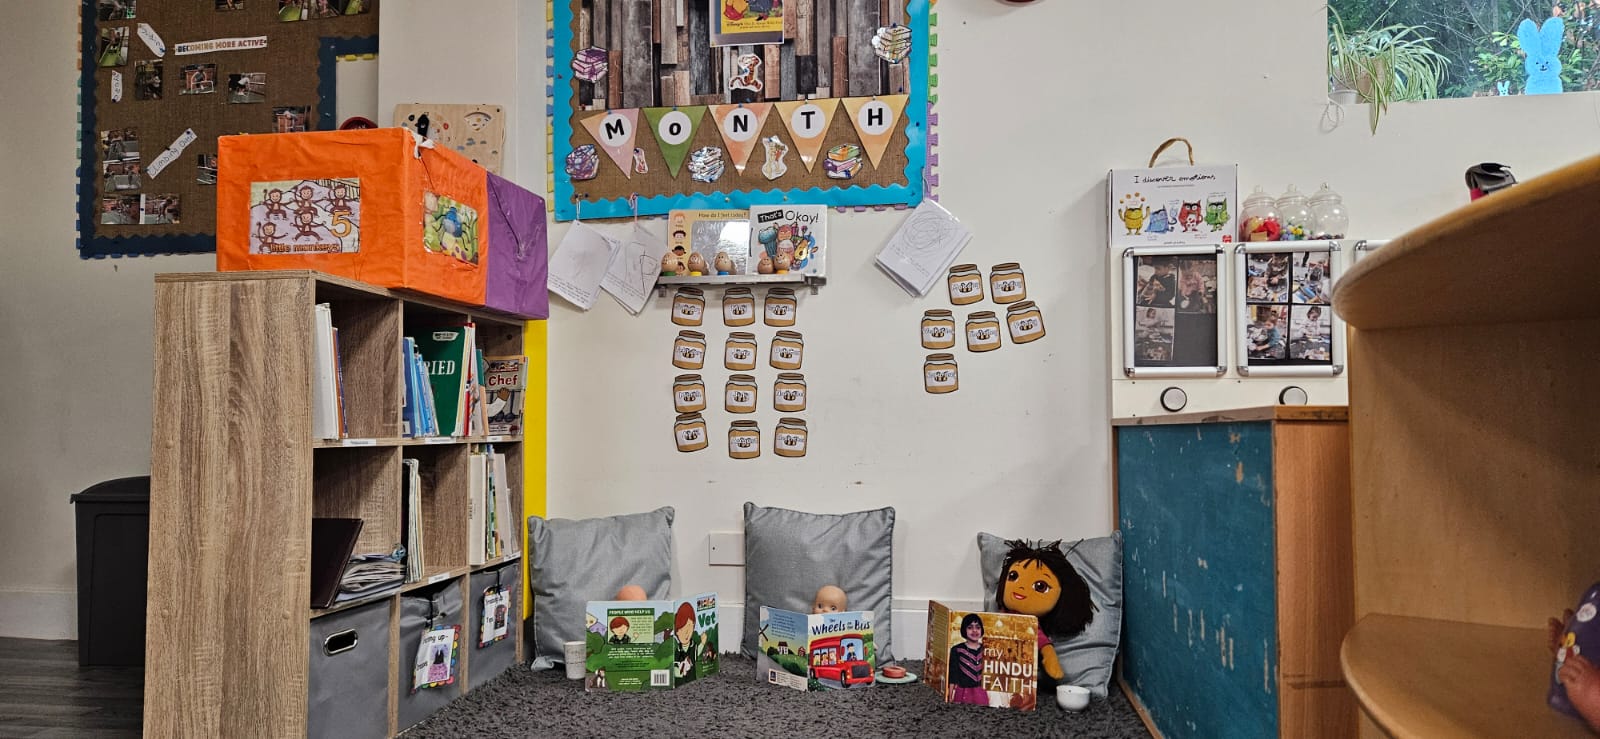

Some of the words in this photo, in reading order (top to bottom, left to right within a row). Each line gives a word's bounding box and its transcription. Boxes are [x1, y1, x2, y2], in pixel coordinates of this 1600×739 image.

[177, 43, 214, 53] BECOMING
[215, 40, 236, 49] MORE
[238, 39, 265, 48] ACTIVE
[1133, 175, 1140, 184] I
[330, 209, 352, 239] 5
[760, 210, 782, 222] That's
[785, 210, 819, 225] Okay!
[488, 375, 518, 386] Chef
[698, 611, 716, 628] Vet
[854, 619, 870, 631] Bus
[811, 620, 846, 635] Wheels
[984, 647, 1003, 660] my
[984, 660, 1033, 677] HINDU
[983, 675, 1033, 695] FAITH
